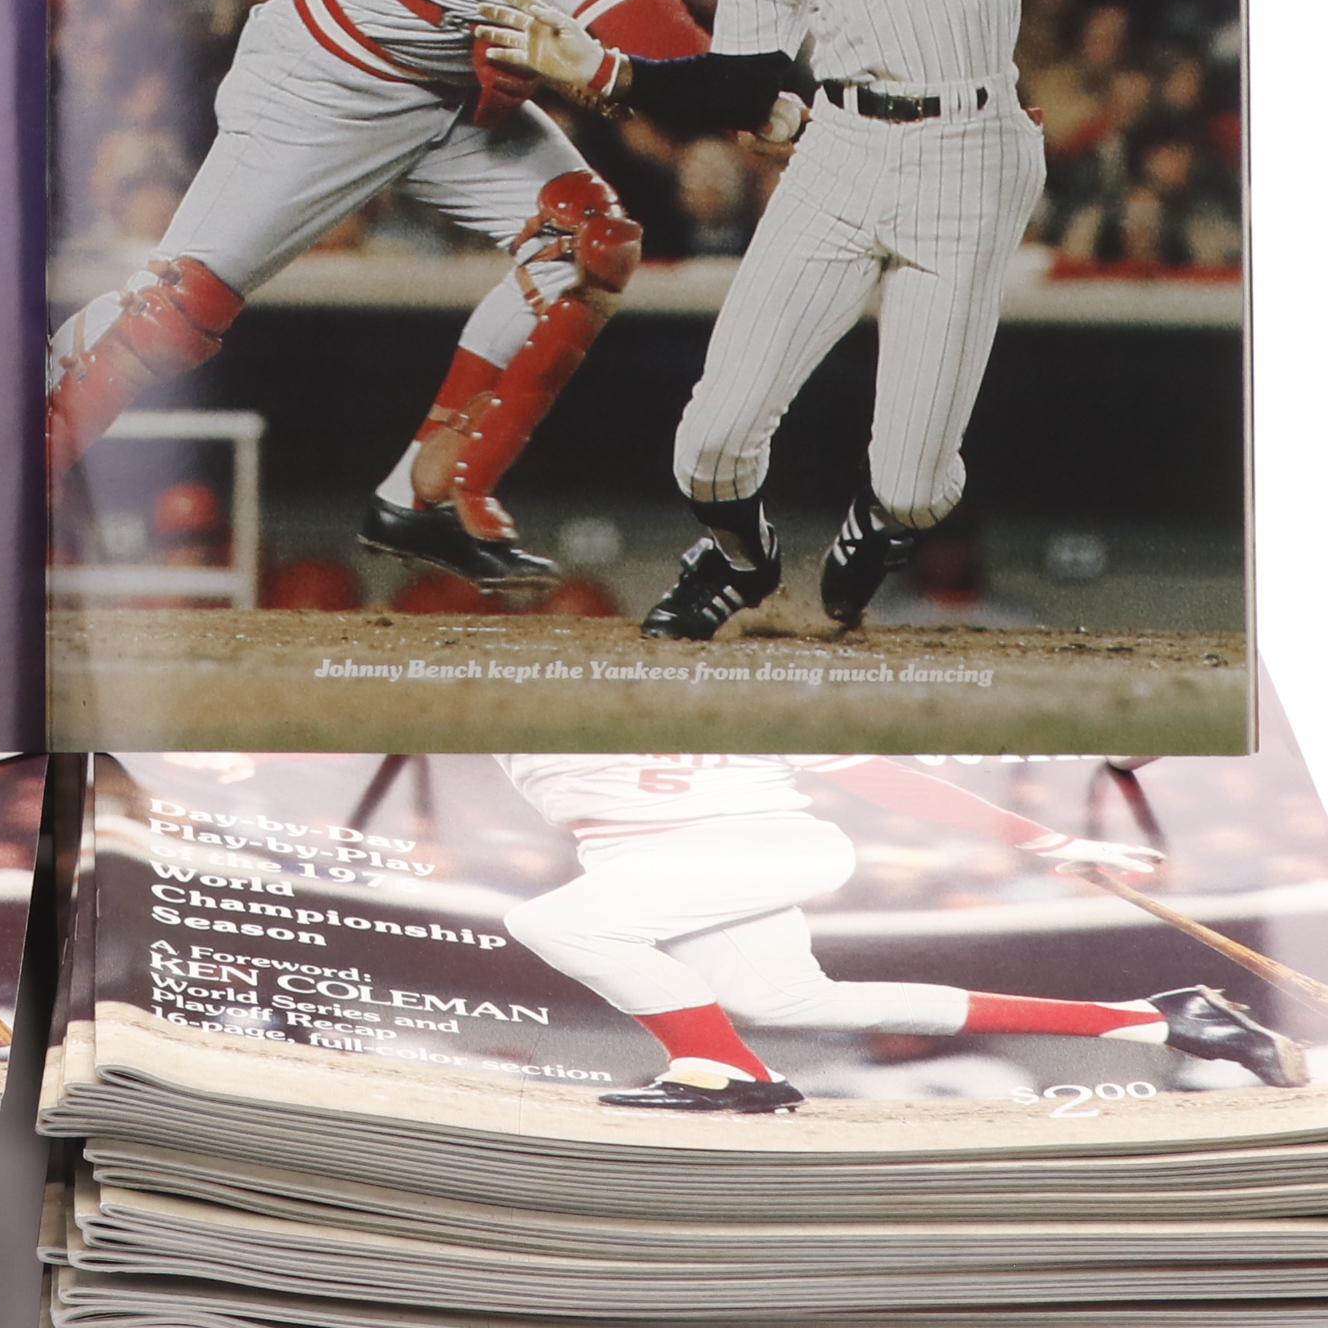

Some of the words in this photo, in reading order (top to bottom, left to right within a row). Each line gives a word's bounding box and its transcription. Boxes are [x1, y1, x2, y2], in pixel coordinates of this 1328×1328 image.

[314, 658, 403, 682] Johnny
[407, 659, 482, 679] Bench
[488, 660, 541, 683] kept
[545, 660, 584, 680] the
[589, 660, 689, 681] Yankees
[690, 662, 751, 685] from
[755, 662, 824, 685] doing
[829, 663, 895, 683] much
[899, 663, 994, 687] dancing
[149, 817, 437, 877] Play-by-Play
[150, 798, 417, 853] Day-by-Day
[149, 860, 295, 897] World
[151, 884, 507, 950] Championship
[152, 905, 327, 947] Season
[149, 950, 260, 987] KEN
[277, 974, 549, 1025] COLEMAN
[150, 939, 178, 956] A
[189, 945, 373, 983] Foreword:
[150, 971, 258, 1005] World
[272, 994, 382, 1023] Series
[394, 1015, 461, 1034] and
[151, 986, 274, 1022] Playoff
[285, 1011, 398, 1041] Recap
[150, 1004, 296, 1045] 16-page,
[307, 1032, 469, 1066] full-color
[480, 1059, 613, 1082] section
